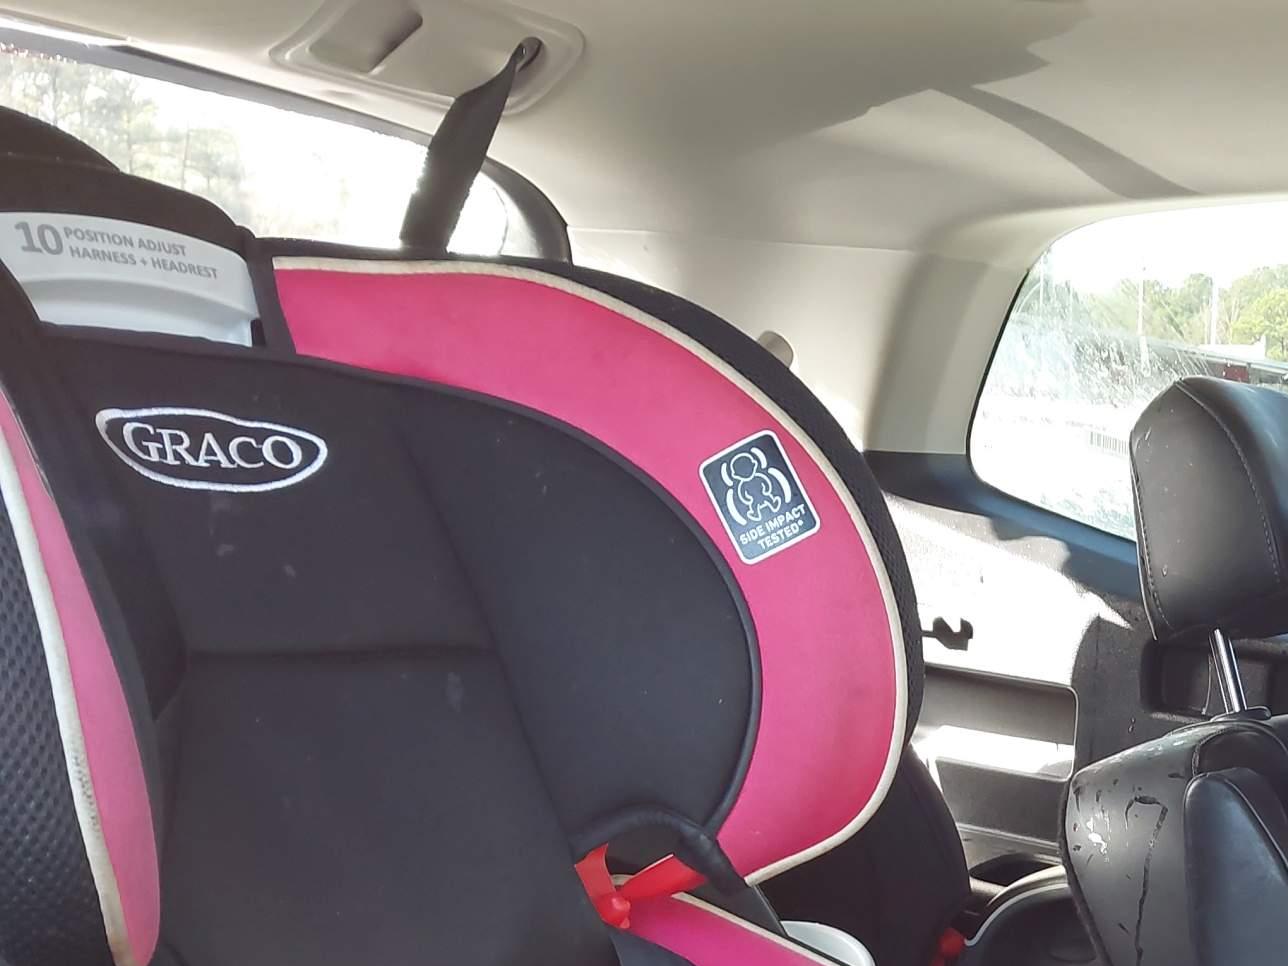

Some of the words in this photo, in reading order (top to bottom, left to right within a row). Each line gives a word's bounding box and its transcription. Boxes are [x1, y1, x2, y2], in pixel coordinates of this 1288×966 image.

[14, 221, 63, 255] 10
[63, 226, 134, 248] POSITION
[138, 236, 187, 256] ADJUST
[69, 246, 136, 265] HARNESS
[151, 256, 218, 279] HEADREST
[122, 421, 303, 470] GRACO
[739, 525, 765, 545] SIDE
[765, 504, 806, 532] IMPACT
